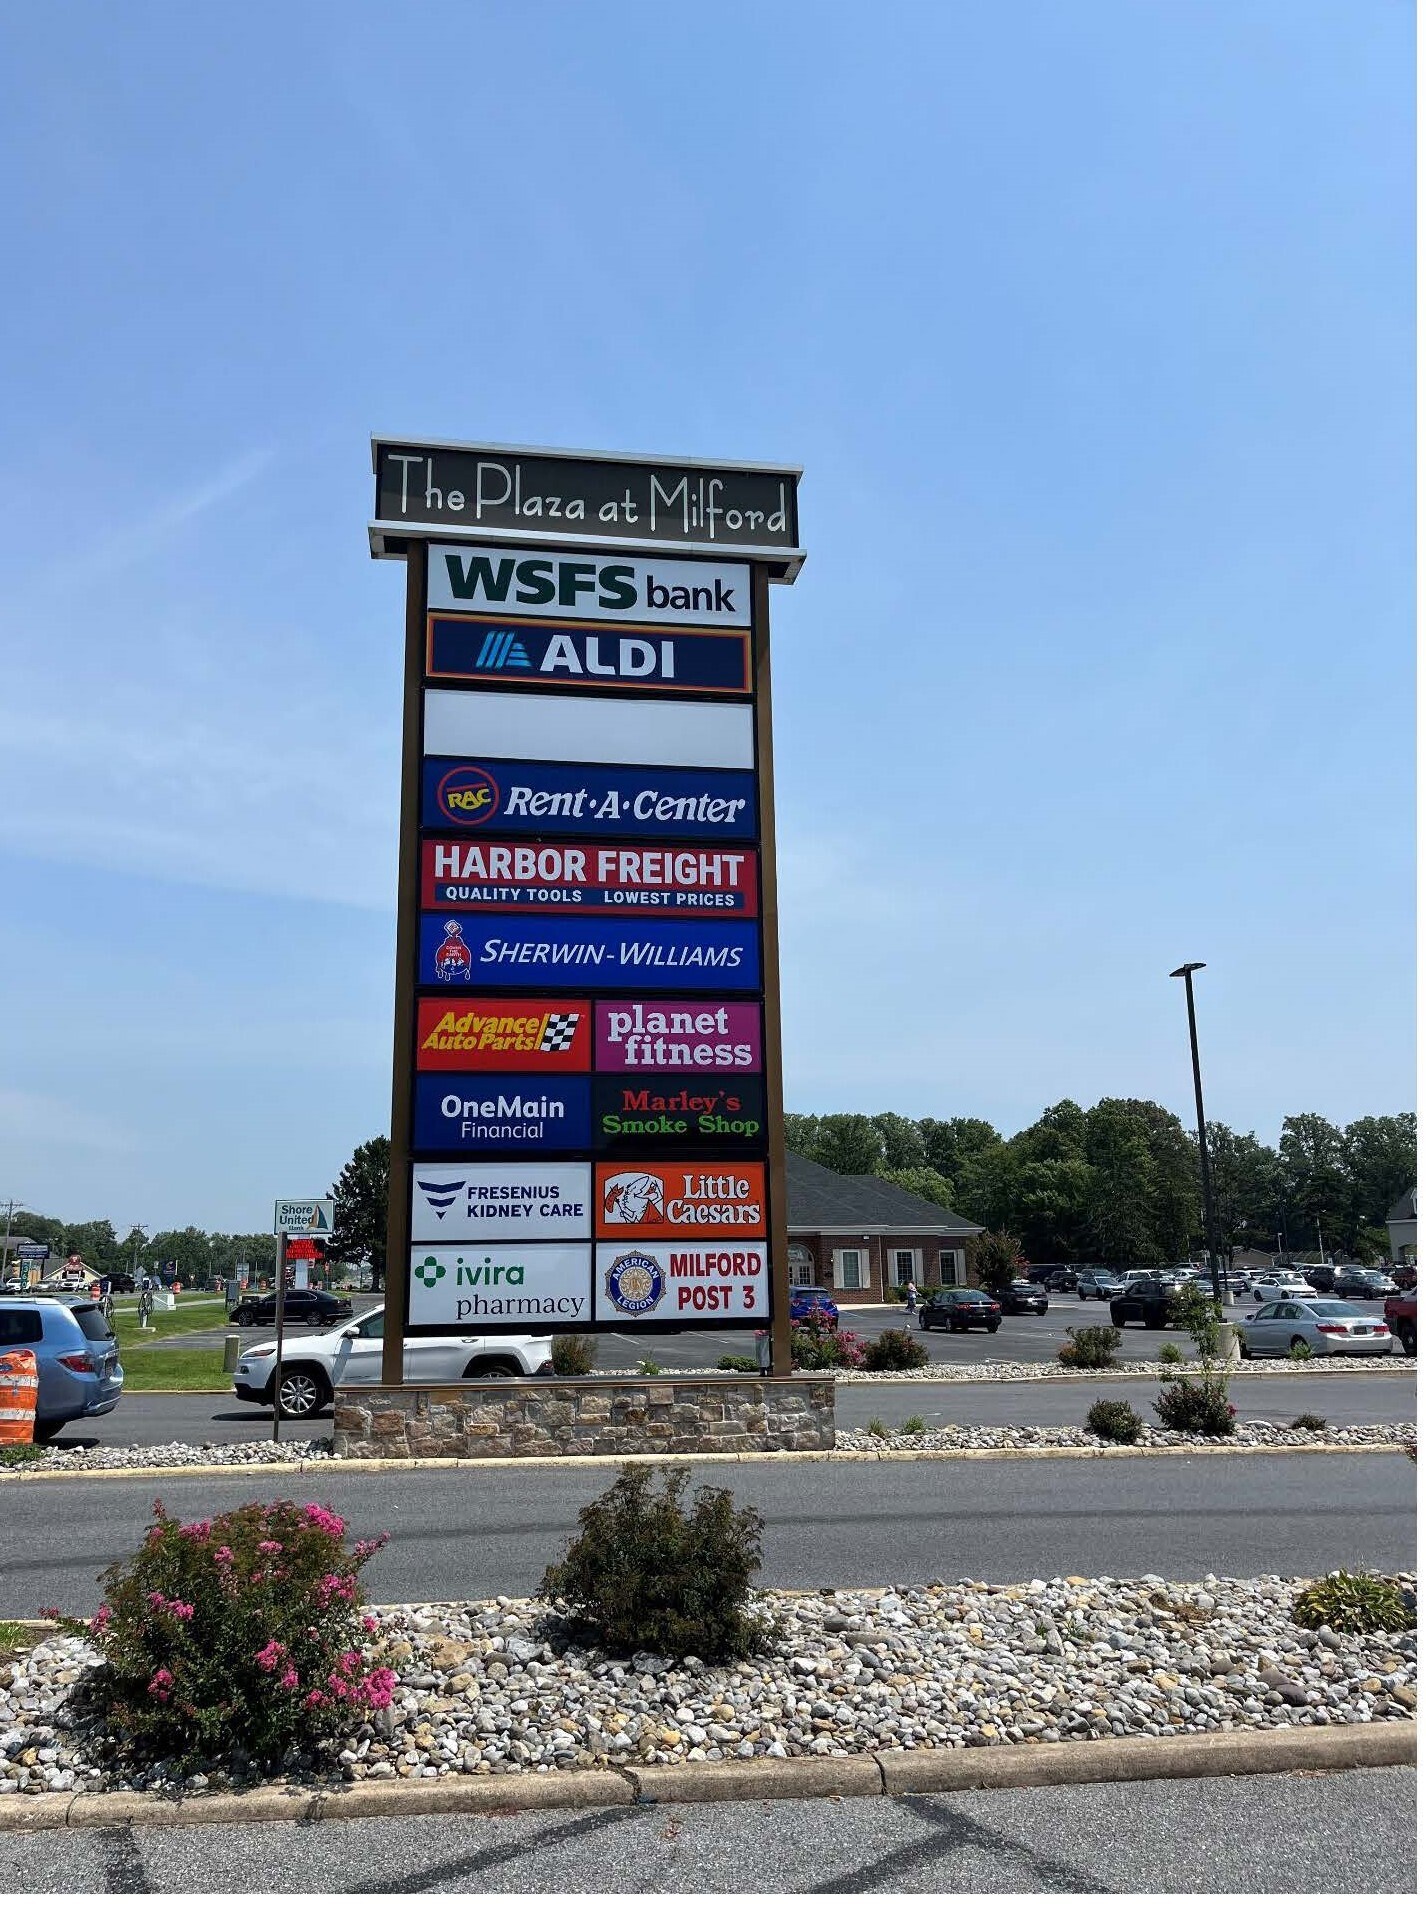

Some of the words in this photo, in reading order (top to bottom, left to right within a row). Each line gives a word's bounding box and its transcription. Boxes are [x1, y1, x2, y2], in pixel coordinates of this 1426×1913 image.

[388, 454, 465, 514] The
[477, 462, 585, 520] Plaza
[599, 489, 639, 524] at
[650, 474, 786, 539] Milford
[445, 554, 638, 610] WSFS
[646, 575, 736, 612] bank
[540, 634, 675, 678] ALDI
[447, 788, 491, 810] RAC
[434, 845, 587, 882] HARBOR
[598, 850, 745, 886] FREIGHT
[446, 886, 521, 902] QUALITY
[527, 888, 582, 903] TOOLS
[604, 890, 671, 905] LOWEST
[676, 892, 735, 907] PRICES
[433, 1012, 540, 1034] Advance
[607, 1004, 729, 1042] planet
[421, 1033, 477, 1050] Auto
[477, 1033, 535, 1050] Parts
[624, 1035, 753, 1066] fitness
[441, 1095, 564, 1119] OneMain
[622, 1090, 742, 1112] Marley's
[461, 1121, 544, 1139] Financial
[602, 1115, 687, 1134] Smoke
[698, 1115, 760, 1136] Shop
[467, 1186, 560, 1200] FRESENIUS
[682, 1174, 750, 1200] Little
[279, 1215, 314, 1225] United
[281, 1204, 313, 1215] Shore
[467, 1204, 536, 1218] KIDNEY
[539, 1203, 584, 1217] CARE
[666, 1200, 761, 1225] Caesars
[456, 1256, 525, 1287] ivira
[612, 1257, 660, 1281] AMERICAN
[669, 1252, 762, 1278] MILFORD
[456, 1292, 586, 1321] pharmacy
[616, 1295, 655, 1310] LEGION
[677, 1285, 733, 1311] POST
[742, 1285, 756, 1310] 3
